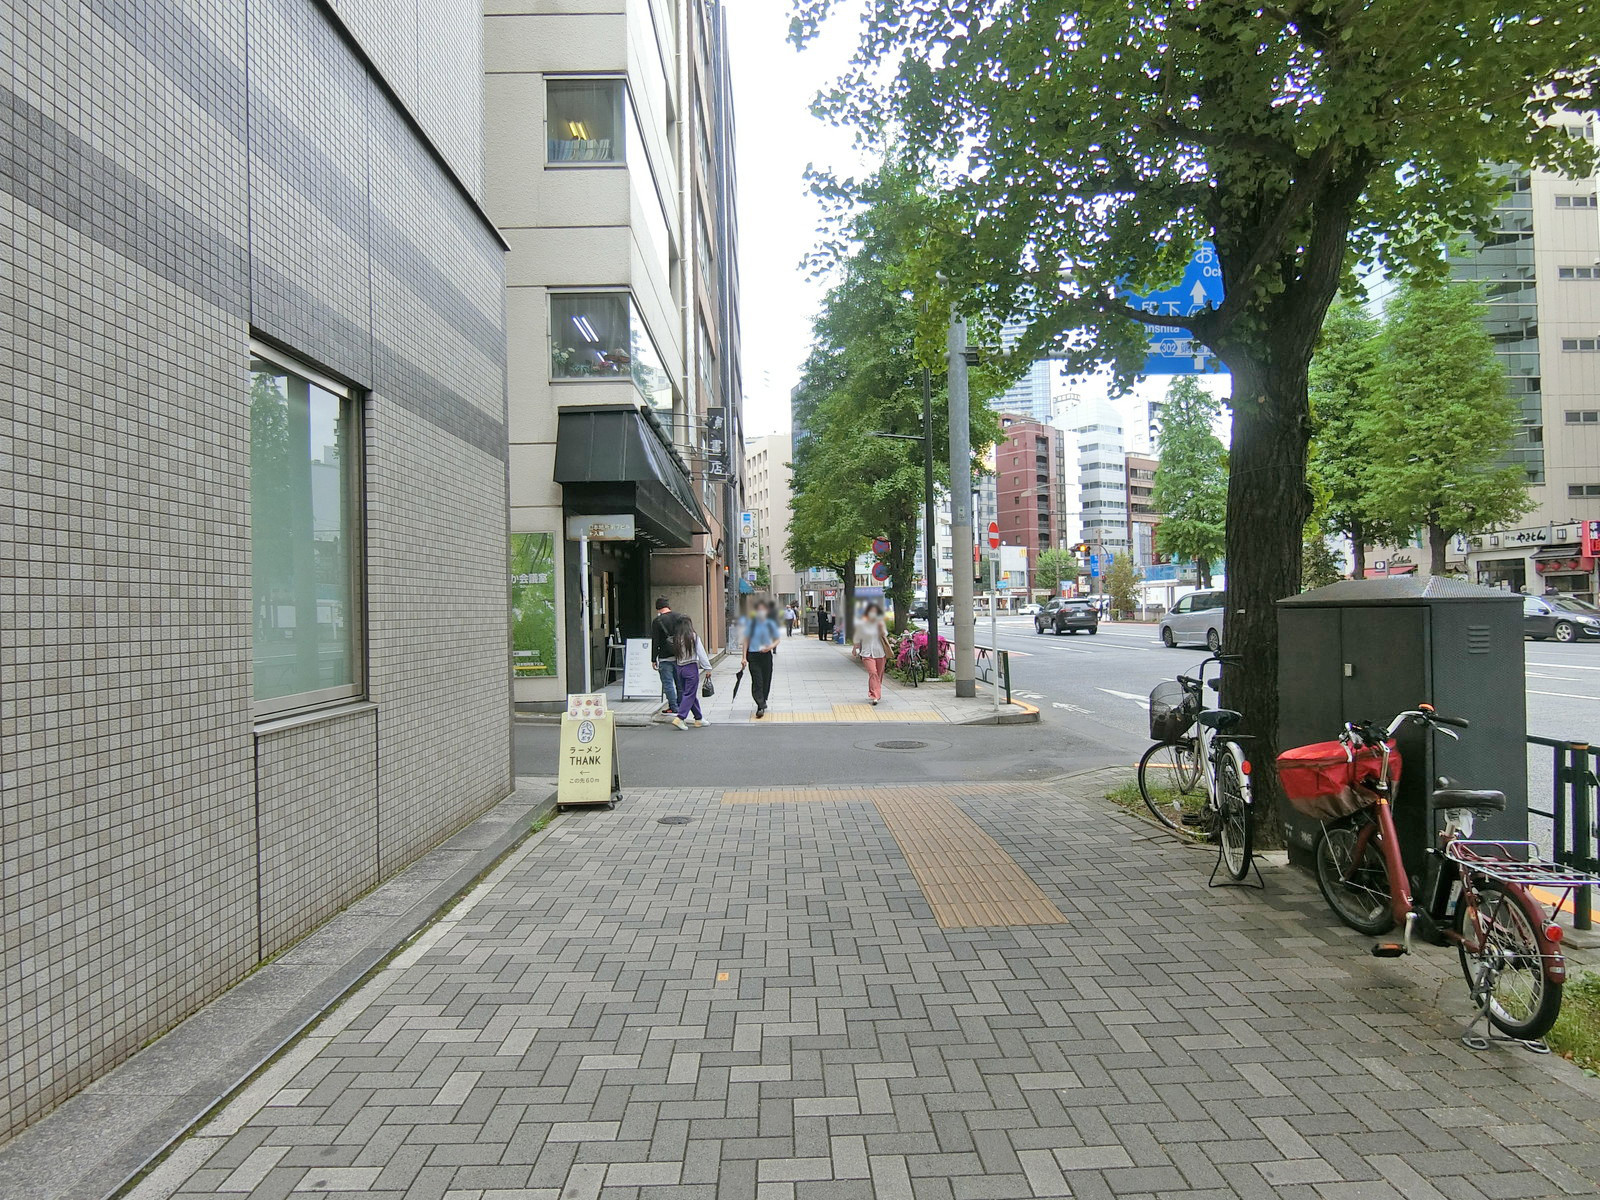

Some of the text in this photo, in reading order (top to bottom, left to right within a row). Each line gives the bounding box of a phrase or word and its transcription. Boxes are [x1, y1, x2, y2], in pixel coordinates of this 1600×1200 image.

[1161, 343, 1176, 353] 302
[1516, 530, 1547, 543] やきとん
[569, 746, 602, 754] ラーメン
[569, 756, 601, 766] THANK
